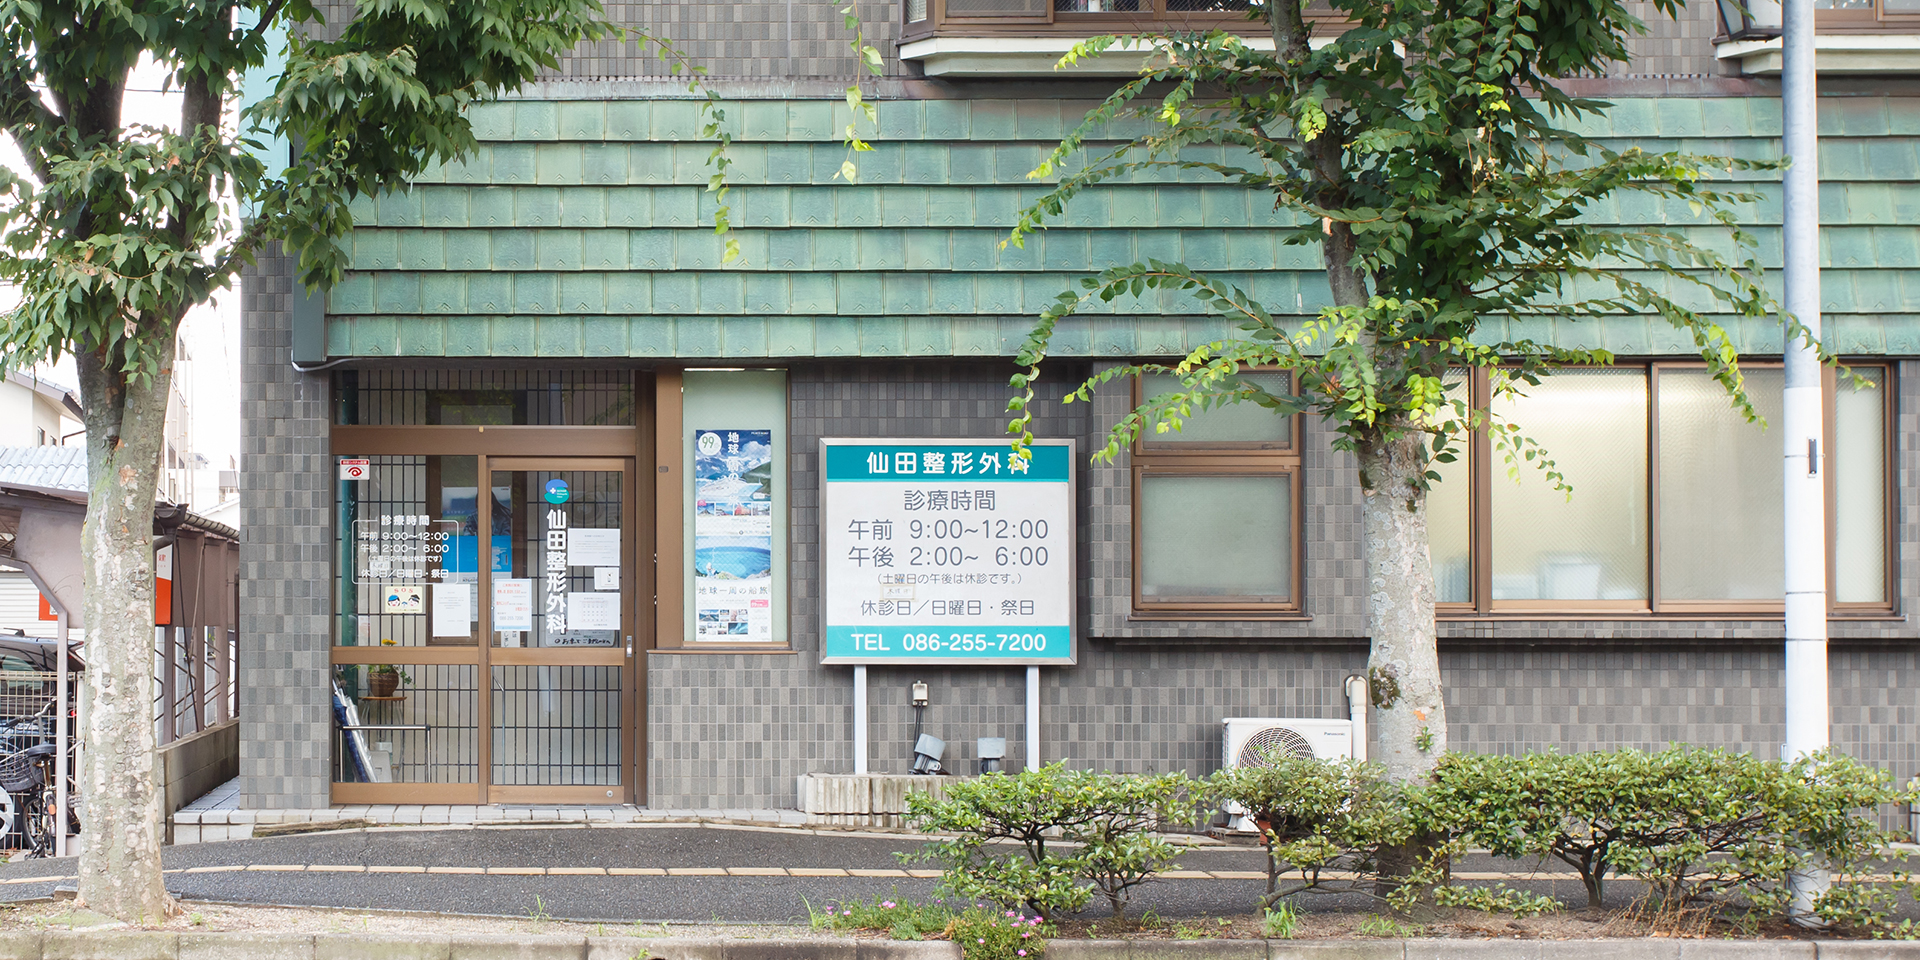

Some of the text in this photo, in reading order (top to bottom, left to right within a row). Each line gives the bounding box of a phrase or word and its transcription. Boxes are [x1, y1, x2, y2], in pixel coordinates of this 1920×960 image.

[867, 452, 1030, 475] 仙田整形外科
[904, 490, 996, 511] 診療時間
[381, 515, 430, 526] 診療時間
[848, 519, 893, 541] 午前
[360, 532, 378, 541] 午前
[360, 544, 378, 553] 午後
[422, 544, 449, 553] 6:00
[848, 546, 894, 568] 午後
[995, 546, 1049, 566] 6:00
[546, 508, 567, 634] 仙田整形外科
[699, 586, 768, 595] 地球一周の船旅
[851, 633, 1047, 651] TEL 086-255-7200
